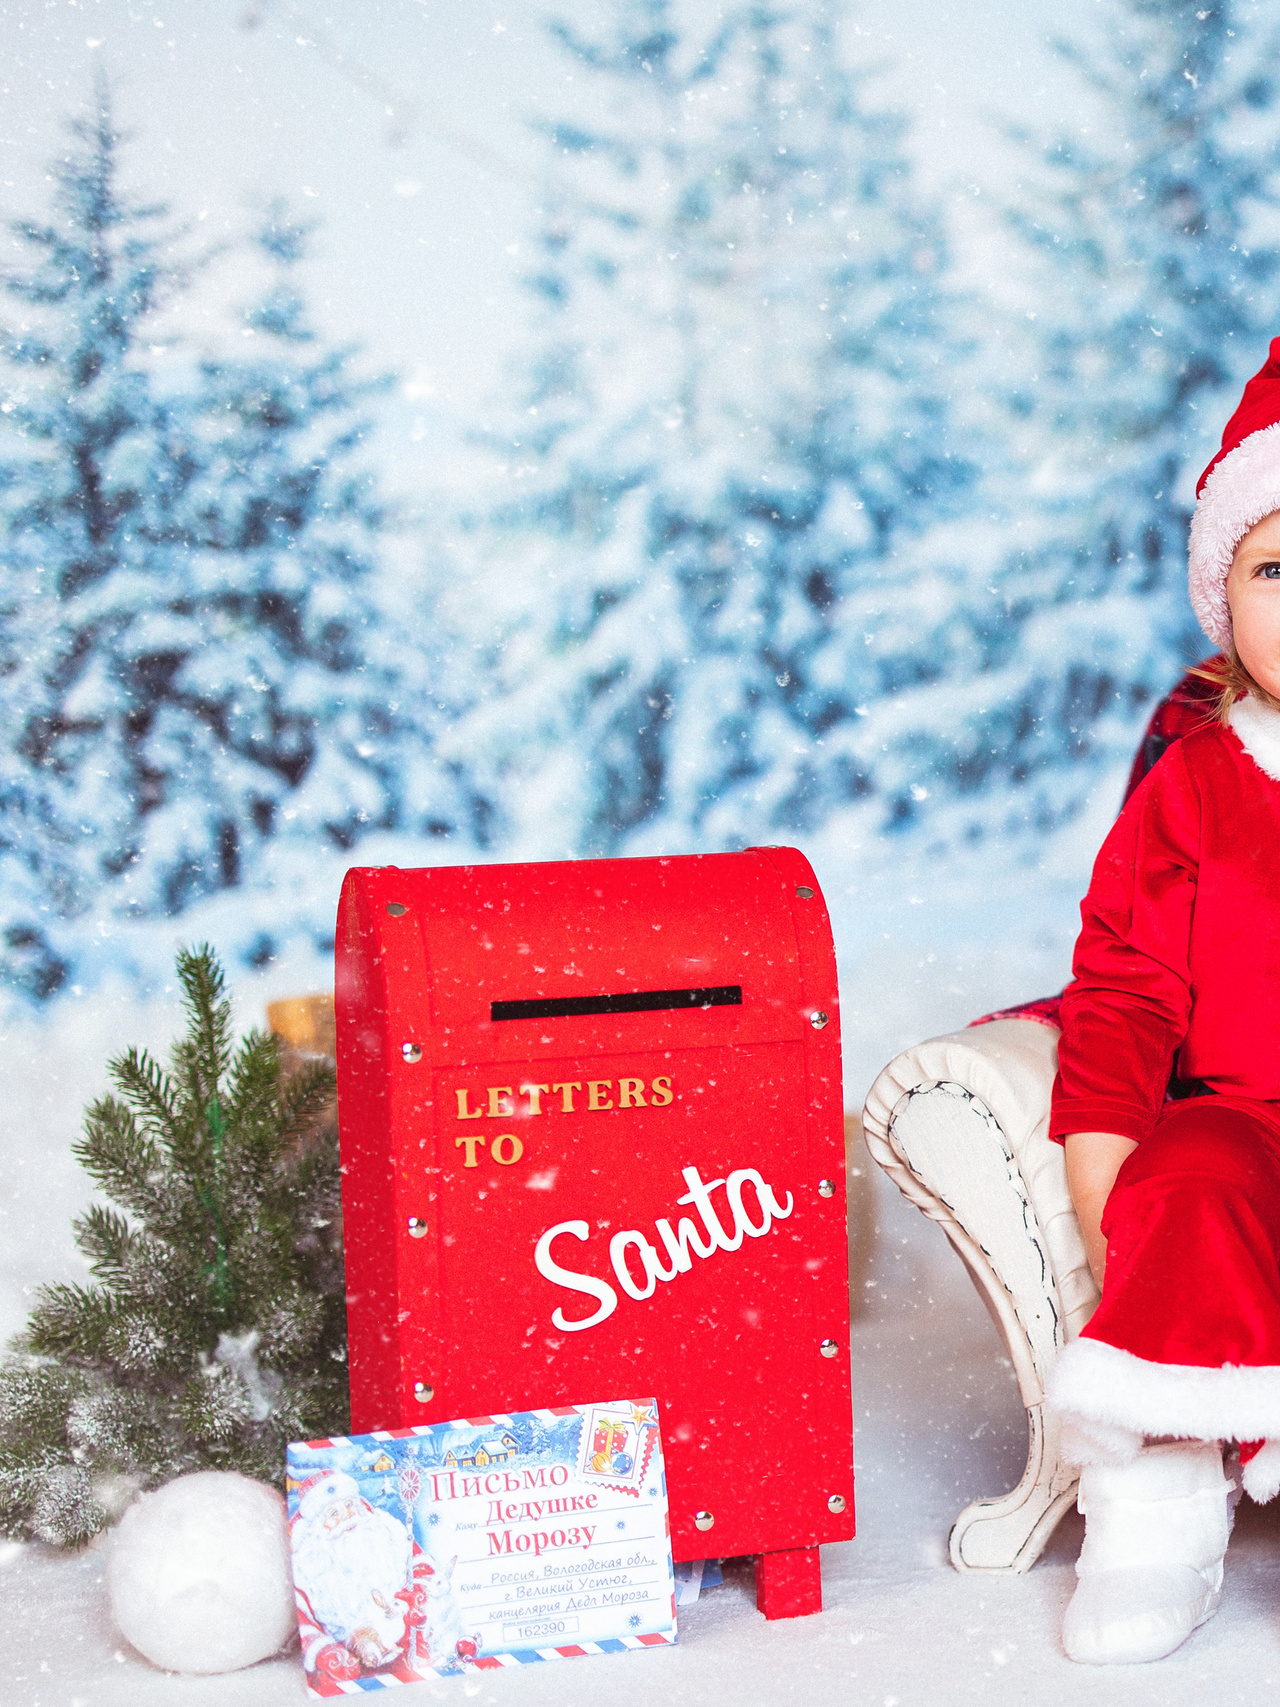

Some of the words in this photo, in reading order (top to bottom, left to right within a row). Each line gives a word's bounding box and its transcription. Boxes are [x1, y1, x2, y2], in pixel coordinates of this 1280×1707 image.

[455, 1076, 674, 1121] LETTERS
[455, 1133, 524, 1169] TO
[534, 1165, 794, 1333] Santa
[430, 1465, 569, 1502] Письмо
[486, 1493, 599, 1526] Дедушке
[486, 1525, 598, 1557] Морозу
[490, 1569, 540, 1584] Россия,
[543, 1557, 622, 1577] Вологодская
[488, 1601, 561, 1621] канцелярия
[565, 1596, 598, 1613] Деда
[602, 1589, 650, 1606] Мороза
[516, 1581, 574, 1599] Великий
[516, 1620, 566, 1639] 162390
